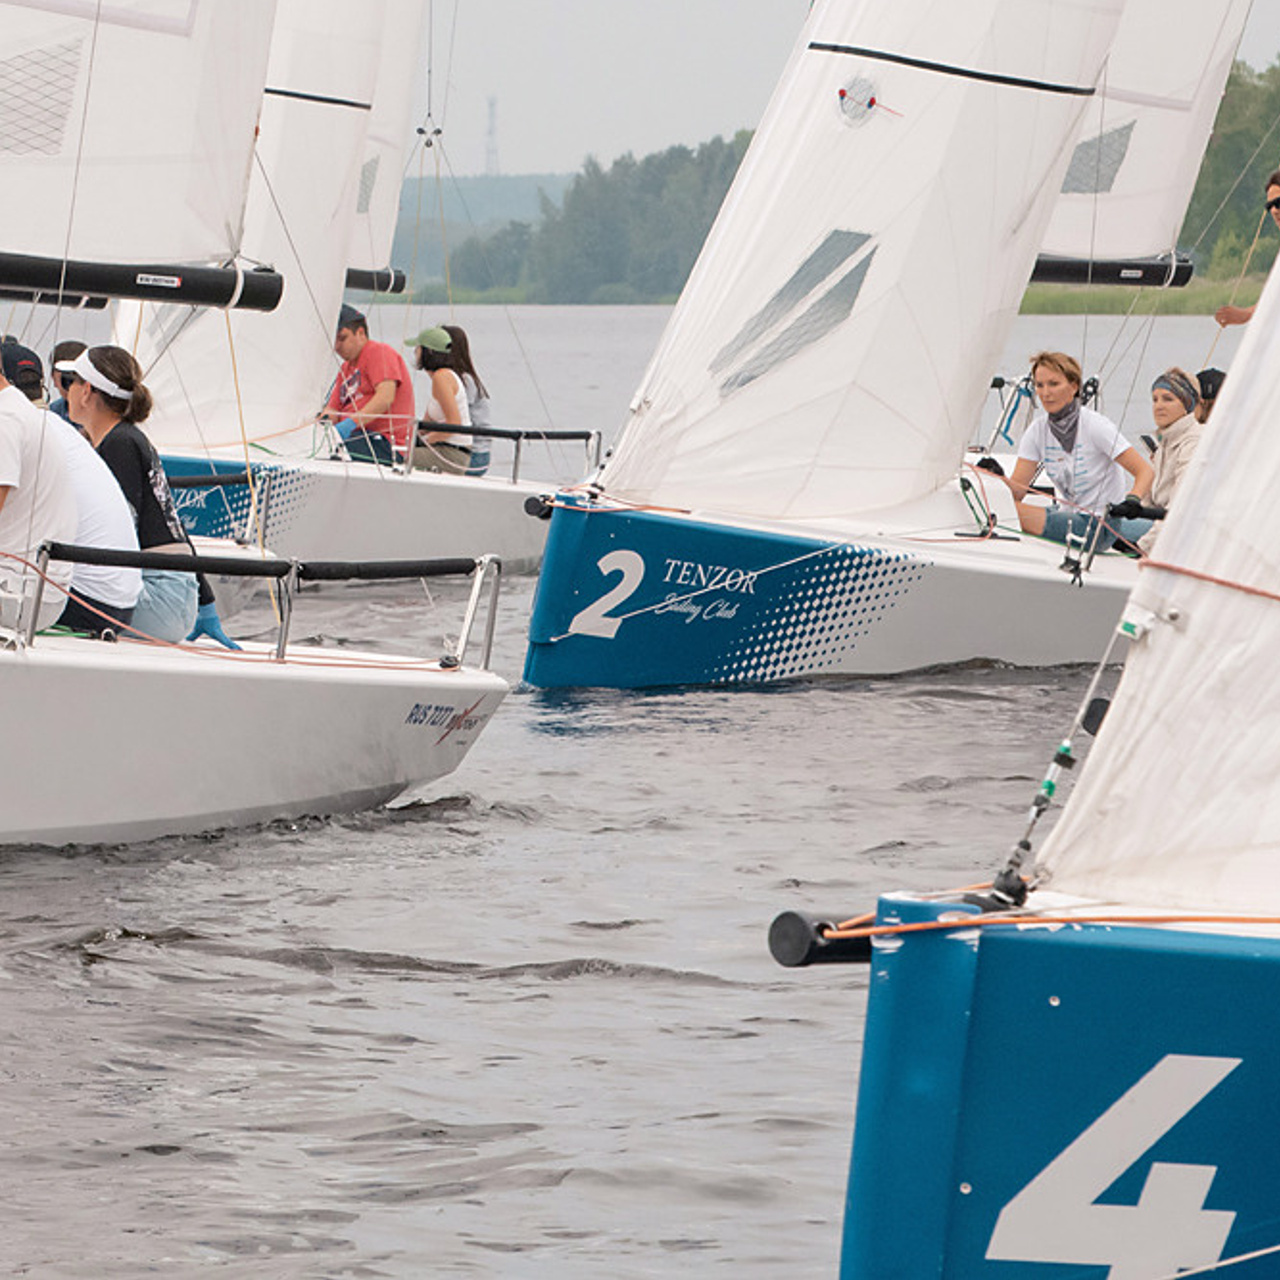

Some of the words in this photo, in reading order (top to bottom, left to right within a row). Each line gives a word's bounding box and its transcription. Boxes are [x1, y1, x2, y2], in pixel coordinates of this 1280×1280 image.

[568, 550, 645, 639] 2
[663, 558, 757, 595] TENZOR
[984, 1053, 1243, 1280] 4
